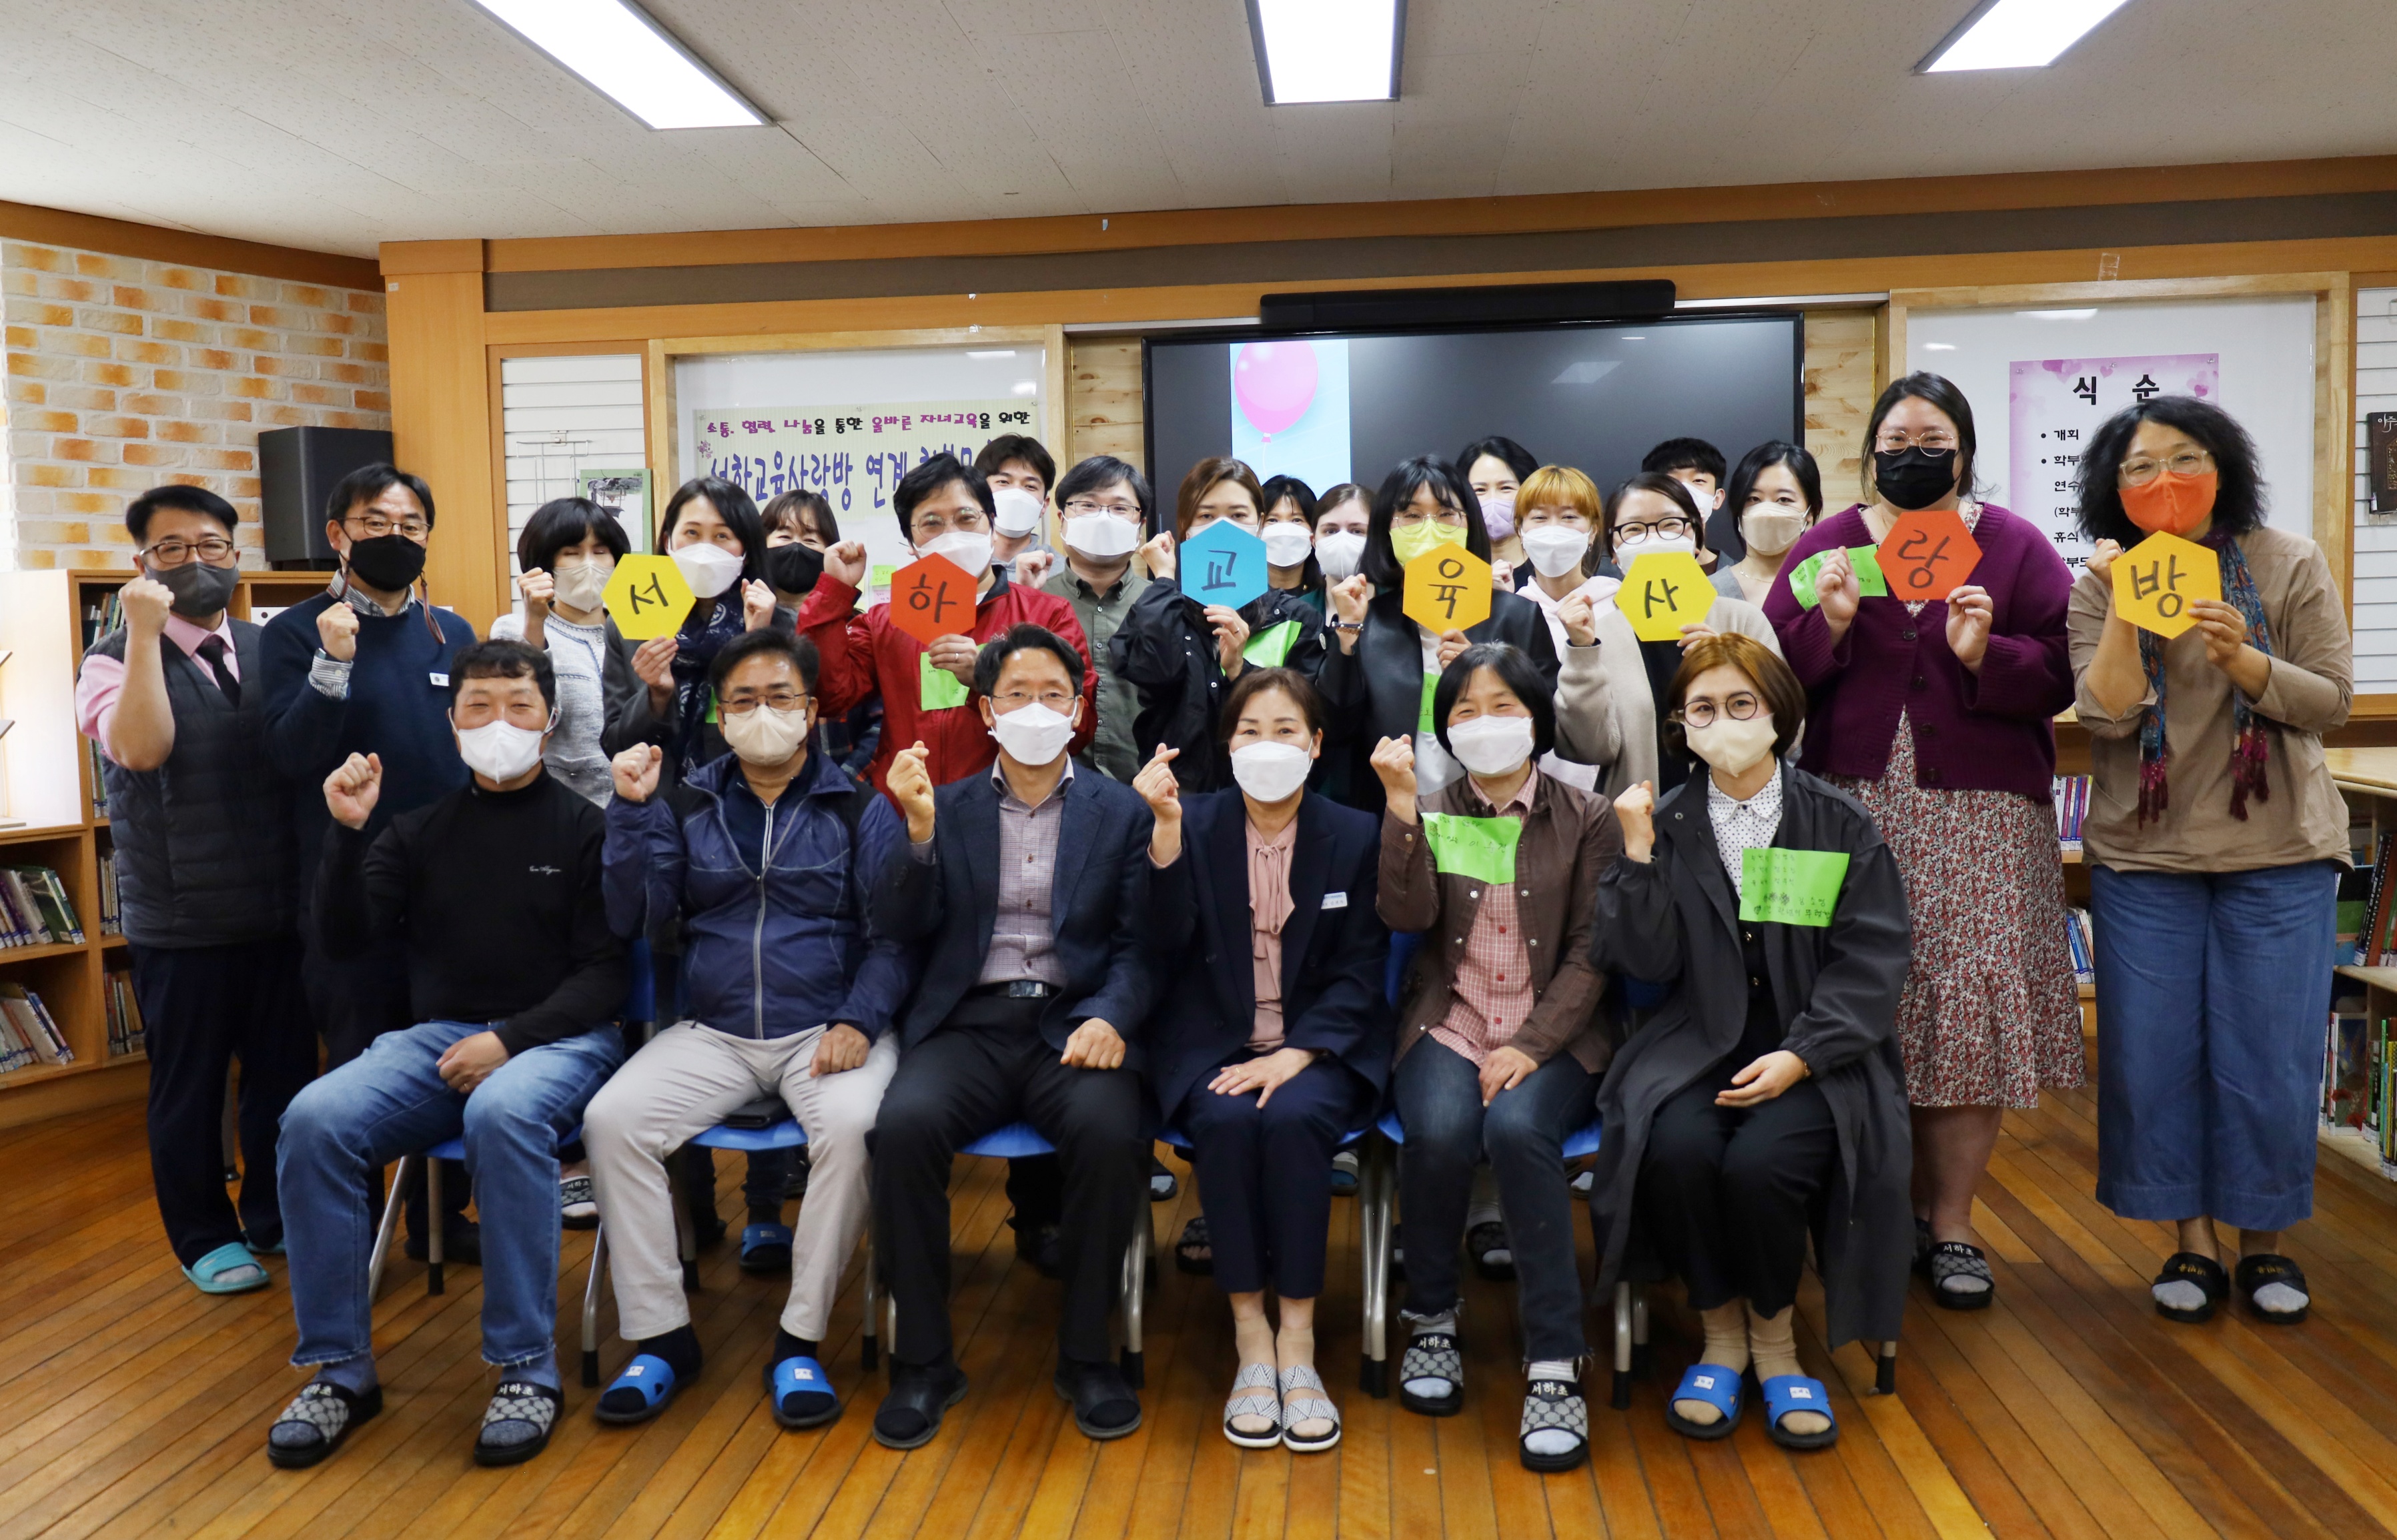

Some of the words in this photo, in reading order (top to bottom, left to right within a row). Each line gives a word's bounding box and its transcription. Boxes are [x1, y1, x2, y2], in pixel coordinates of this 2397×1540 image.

[2073, 376, 2097, 405] 식
[2132, 374, 2160, 402] 순
[784, 419, 825, 435] 나눔을
[835, 417, 863, 434] 통한
[872, 416, 912, 433] 올바른
[920, 412, 990, 430] 자녀교육을
[998, 411, 1030, 424] 위한
[2054, 429, 2079, 441] 개회
[2054, 532, 2079, 543] 휴식
[1201, 550, 1237, 592] 교
[1898, 530, 1951, 589] 랑
[630, 572, 668, 615] 서
[909, 573, 957, 624] 하
[1428, 558, 1468, 620] 육
[1644, 578, 1679, 619] 사
[2131, 554, 2188, 618] 방
[1418, 1336, 1452, 1349] 서하초
[1531, 1381, 1569, 1396] 서하초
